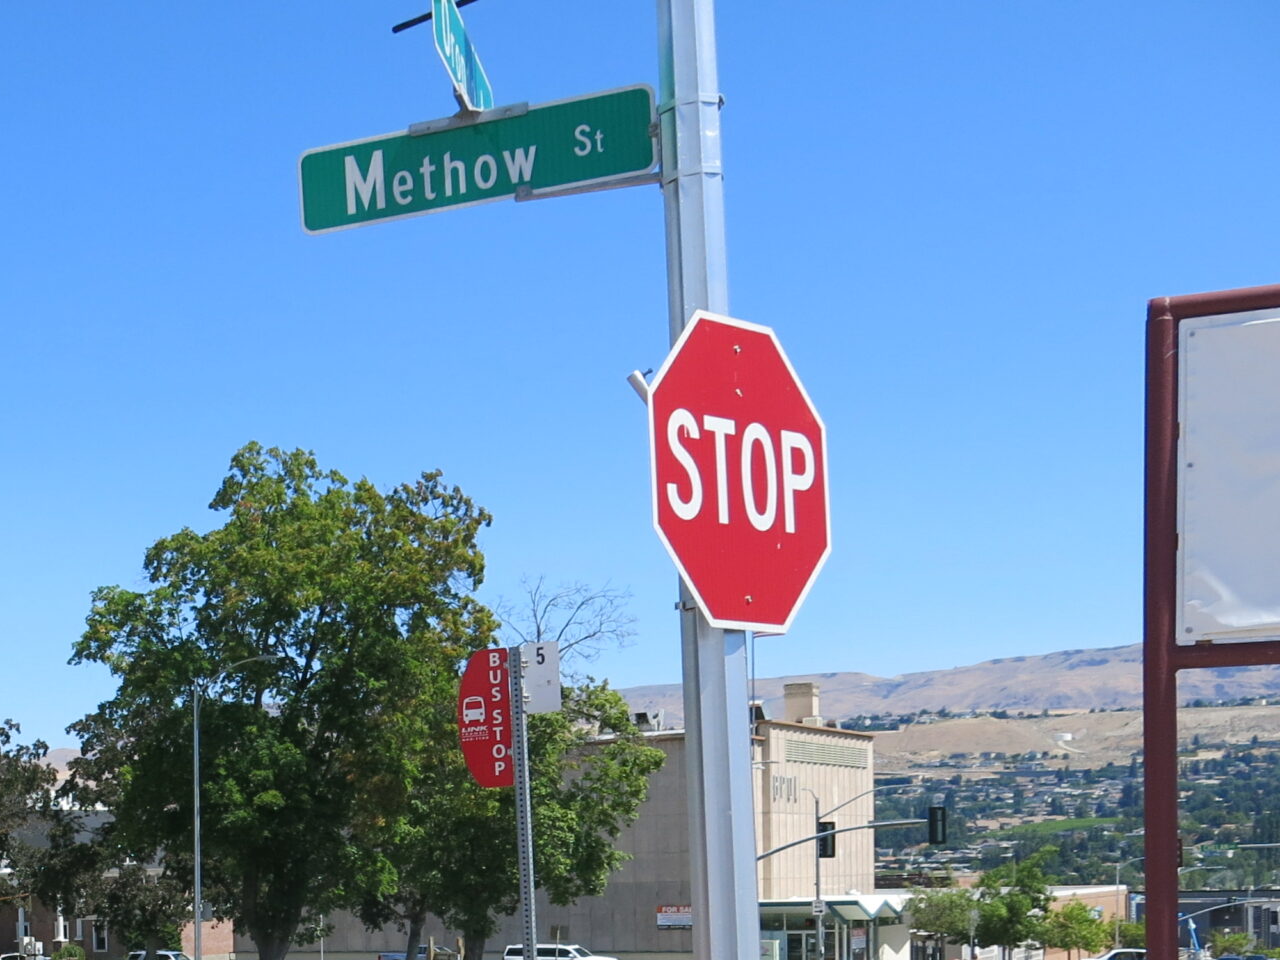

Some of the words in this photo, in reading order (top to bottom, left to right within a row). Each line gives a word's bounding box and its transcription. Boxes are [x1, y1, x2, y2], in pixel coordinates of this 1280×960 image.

[344, 145, 536, 215] Methow
[574, 124, 605, 157] St
[666, 407, 816, 533] STOP
[489, 652, 501, 702] BUS
[536, 647, 545, 665] 5
[493, 709, 506, 776] STOP
[662, 905, 677, 913] FOR
